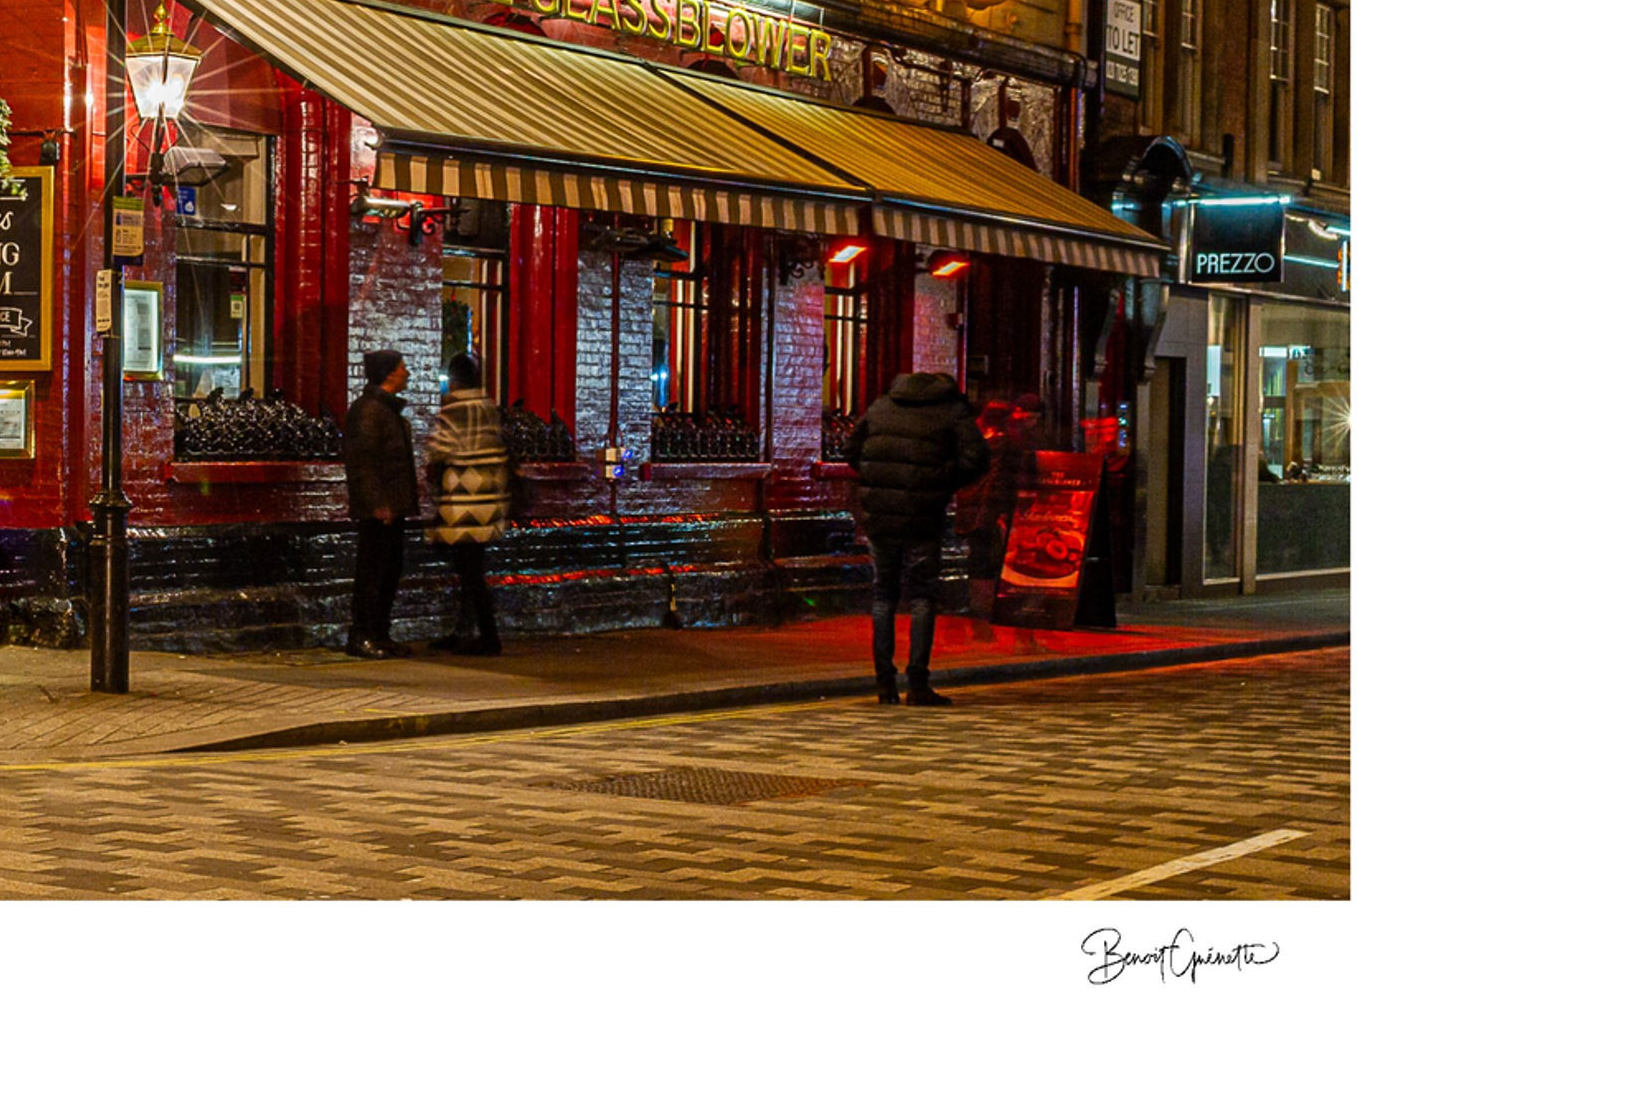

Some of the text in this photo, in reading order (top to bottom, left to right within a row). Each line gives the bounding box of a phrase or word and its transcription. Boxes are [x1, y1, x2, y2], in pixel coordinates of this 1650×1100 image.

[1113, 1, 1134, 23] OFFICE
[1106, 24, 1140, 58] TO LET
[1197, 252, 1276, 274] PREZZO
